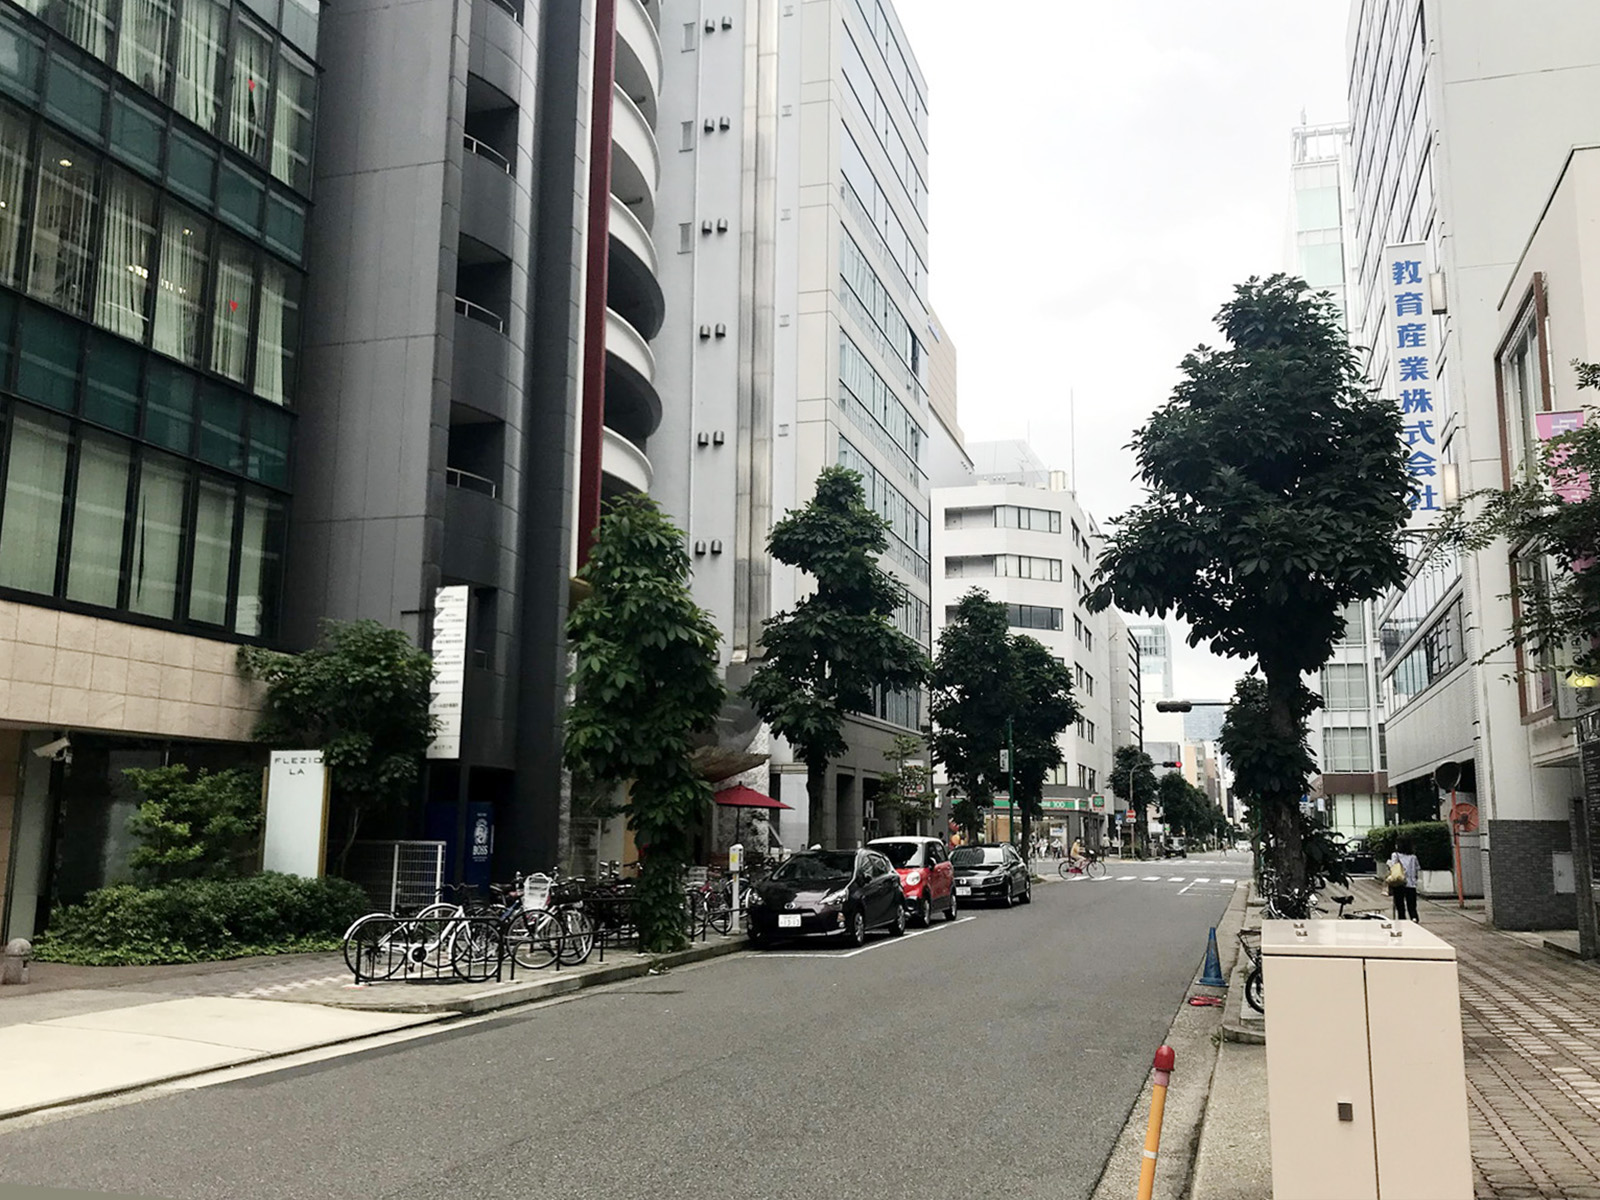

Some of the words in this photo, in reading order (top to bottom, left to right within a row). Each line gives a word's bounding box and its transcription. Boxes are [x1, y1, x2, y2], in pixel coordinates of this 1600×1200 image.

[1392, 260, 1441, 512] 教育産業株式会社
[289, 768, 305, 776] LA
